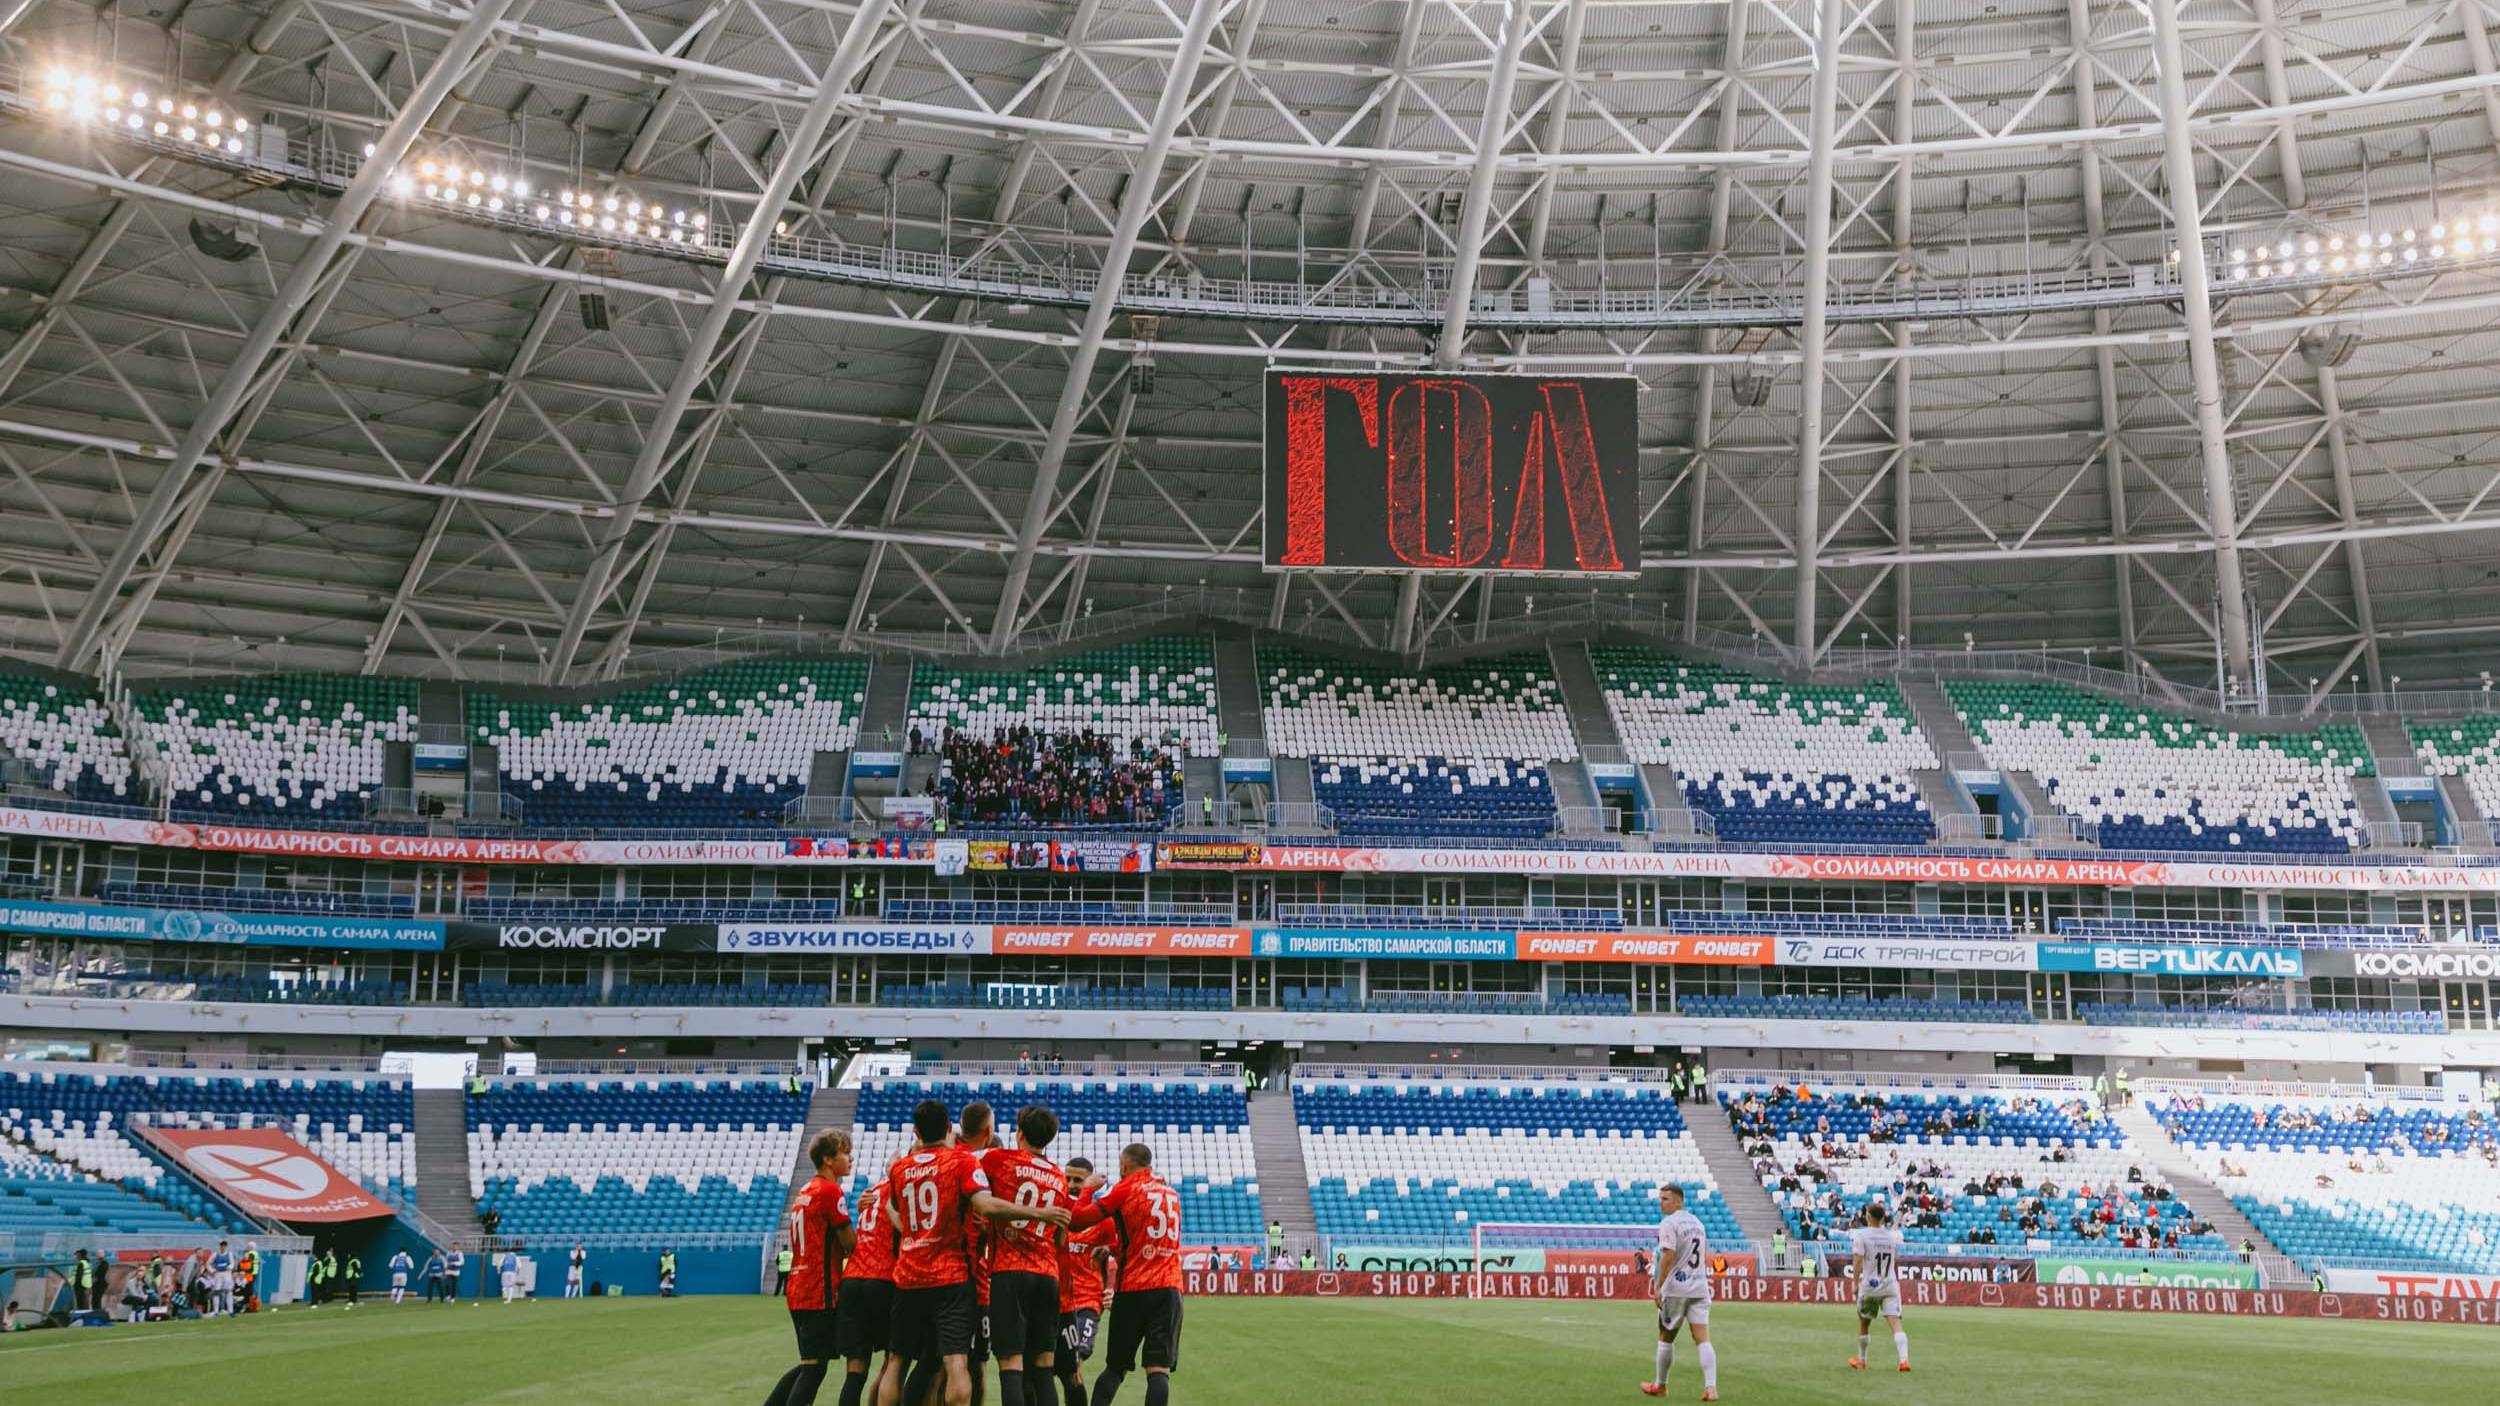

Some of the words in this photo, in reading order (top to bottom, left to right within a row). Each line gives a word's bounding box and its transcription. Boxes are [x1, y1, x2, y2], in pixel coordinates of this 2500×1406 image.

[1281, 378, 1624, 569] ГОЛ
[40, 815, 106, 836] АРЕНА
[200, 829, 371, 855] СОЛИДАРНОСТЬ
[381, 836, 469, 858] САМАРА
[475, 842, 541, 859] АРЕНА
[1280, 851, 1341, 867] АРЕНА
[1421, 853, 1576, 869] СОЛИДАРНОСТЬ
[1585, 855, 1664, 871] САМАРА
[1673, 857, 1731, 872] АРЕНА
[1813, 859, 1970, 877] СОЛИДАРНОСТЬ
[1977, 862, 2058, 879] САМАРА
[2066, 864, 2127, 881] АРЕНА
[2208, 867, 2369, 884] СОЛИДАРНОСТЬ
[11, 909, 85, 931] САМАРСКОЙ
[88, 914, 146, 933] ОБЛАСТИ
[213, 921, 325, 937] СОЛИДАРНОСТЬ
[332, 924, 389, 940] САМАРА
[394, 926, 437, 941] АРЕНА
[500, 926, 666, 949] КОСМОПОРТ
[746, 931, 836, 947] ЗВУКИ
[843, 931, 955, 949] ПОБЕДЫ
[1004, 932, 1073, 948] FONBET
[1087, 932, 1156, 948] FONBET
[1170, 933, 1239, 949] FONBET
[1289, 936, 1382, 953] ПРАВИТЕЛЬСТВО
[1385, 936, 1451, 954] САМАРСКОЙ
[1454, 938, 1506, 954] ОБЛАСТИ
[1529, 938, 1598, 954] FONBET
[1611, 940, 1680, 956] FONBET
[1693, 941, 1762, 957] FONBET
[1823, 945, 1865, 960] ДСК
[1876, 946, 2026, 963] ТРАНССТРОЙ
[2095, 948, 2298, 974] ВЕРТИКАЛЬ
[902, 1181, 938, 1232] 19
[1147, 1192, 1179, 1241] 35
[1688, 1238, 1700, 1269] 3
[1875, 1252, 1892, 1278] 17
[2036, 1285, 2285, 1314] SHOP.FCAKRON.RU
[982, 1316, 990, 1338] 8
[1062, 1324, 1079, 1350] 10
[1083, 1318, 1094, 1338] 5
